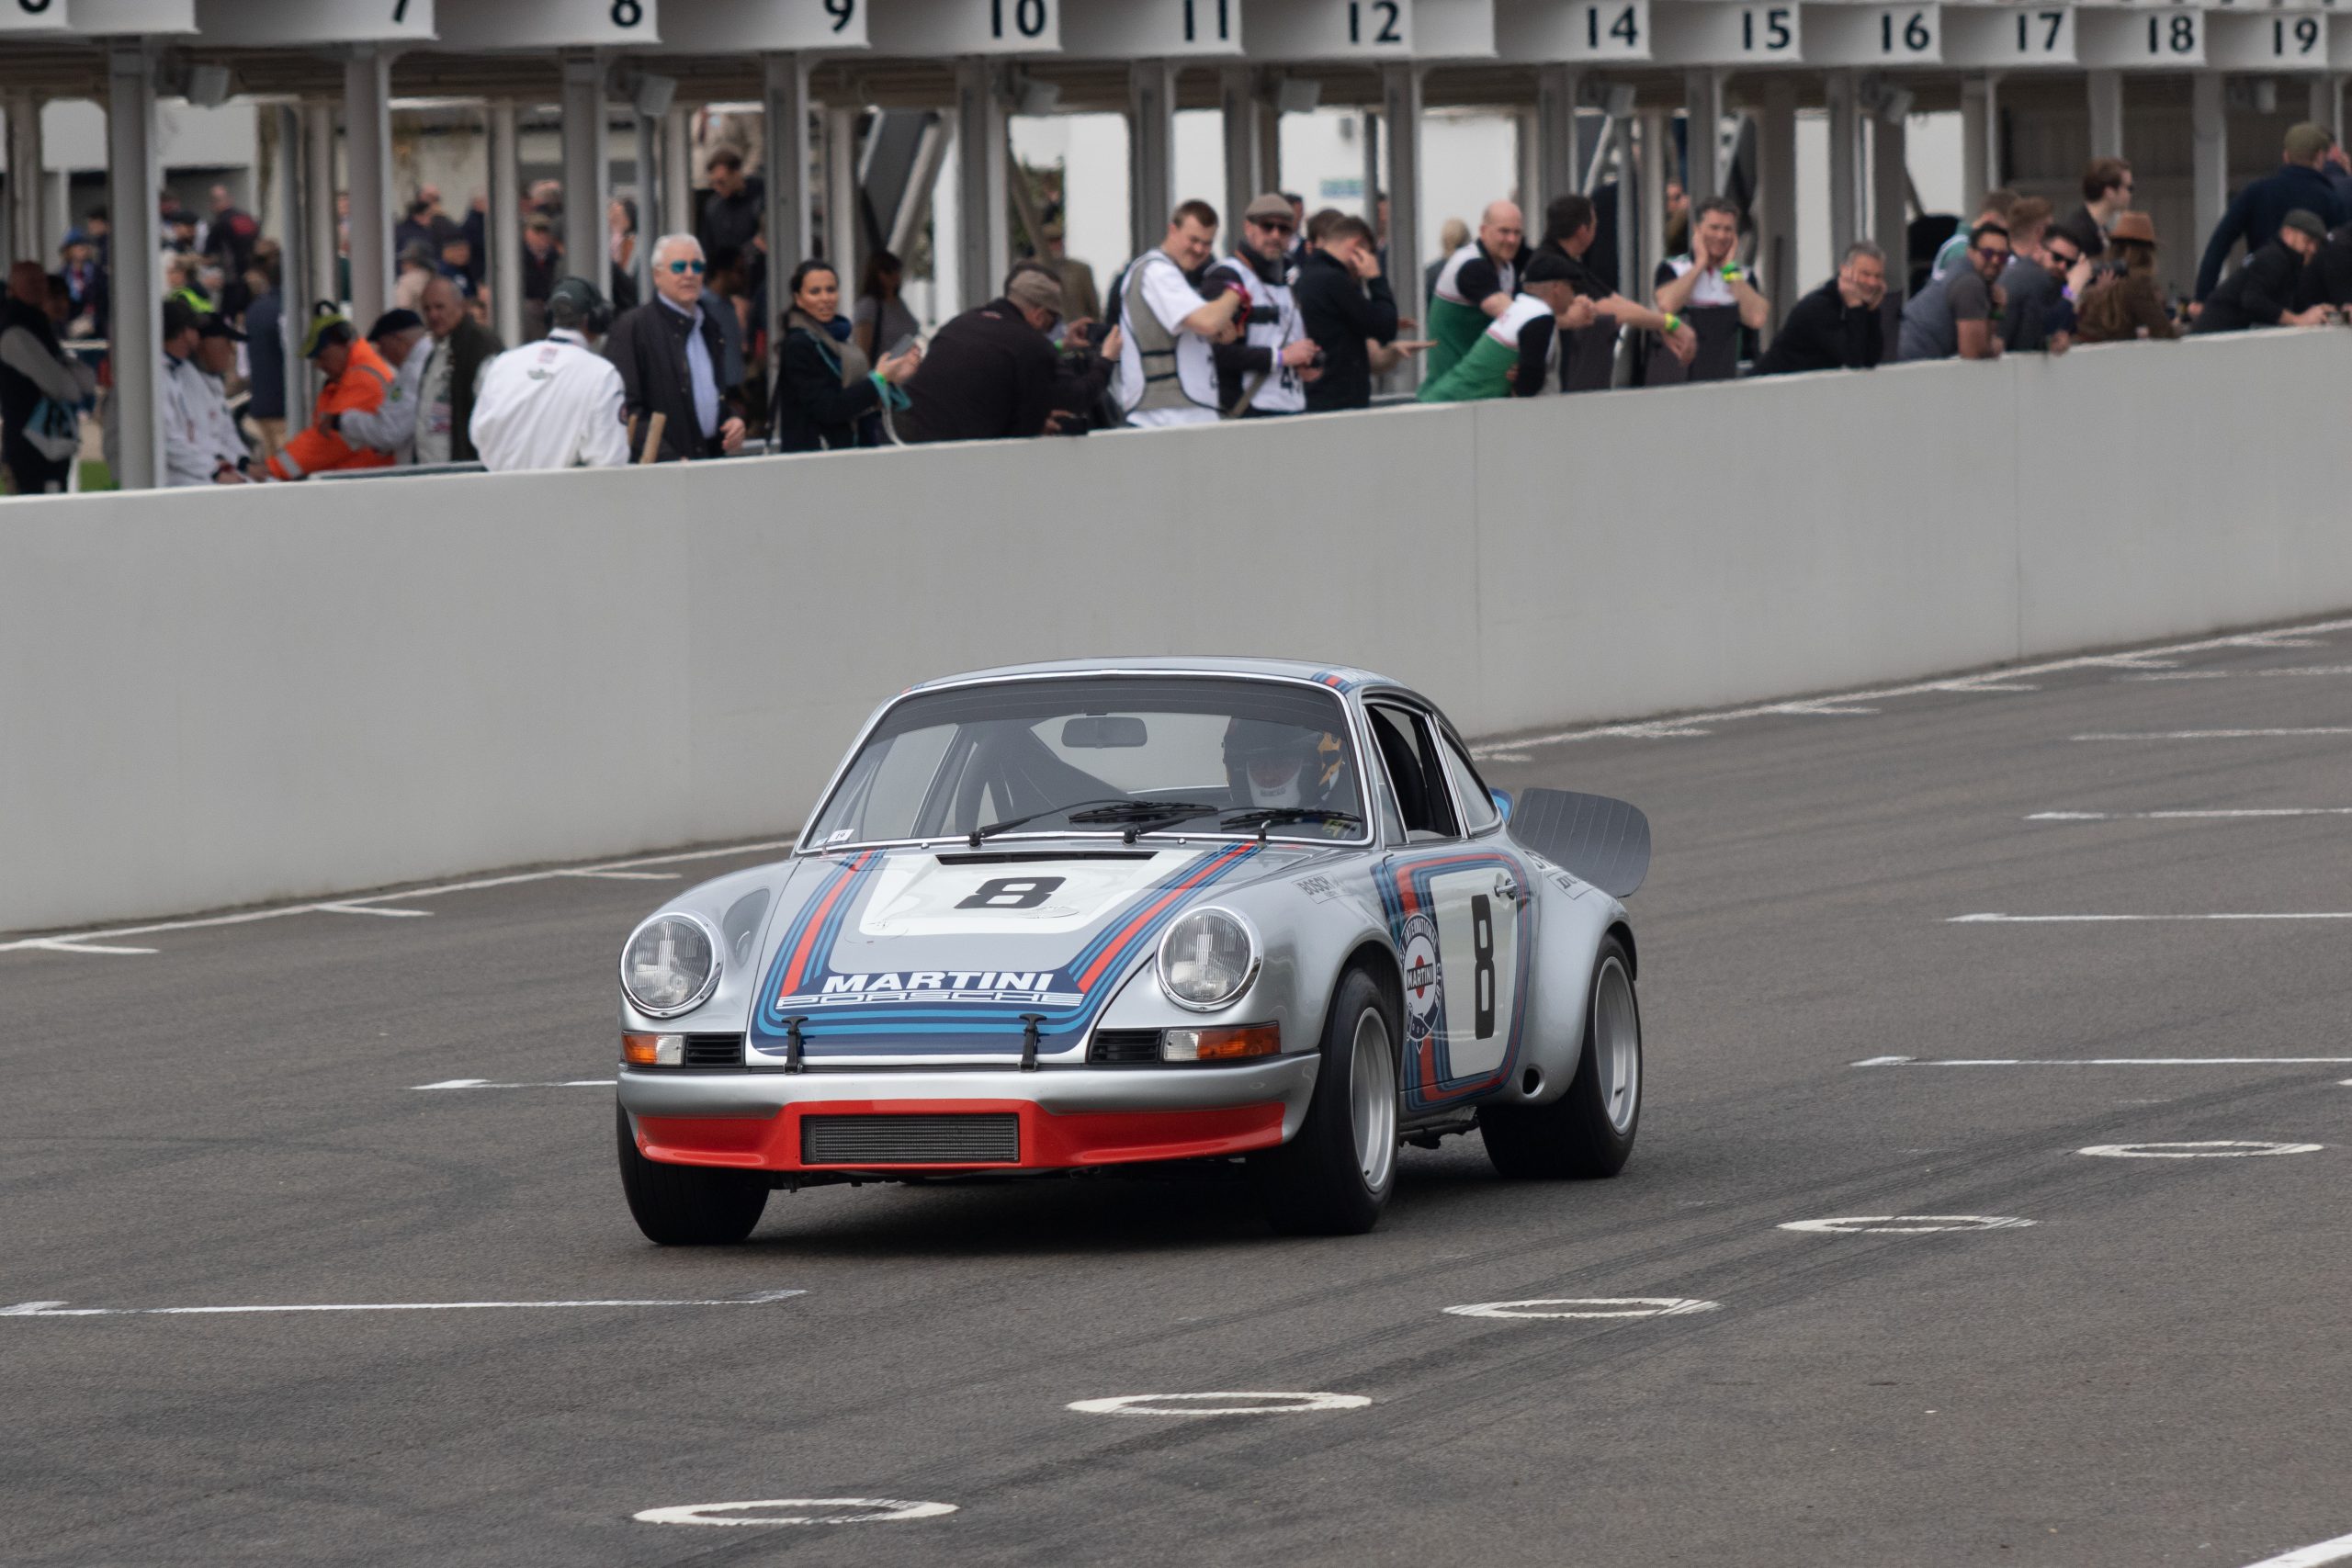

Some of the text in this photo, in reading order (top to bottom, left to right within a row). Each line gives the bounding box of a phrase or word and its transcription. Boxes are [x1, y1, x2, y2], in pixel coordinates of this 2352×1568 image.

[823, 0, 854, 33] 9
[991, 0, 1046, 38] 10
[1184, 0, 1228, 41] 11
[1349, 1, 1402, 43] 12
[1588, 6, 1638, 47] 14
[1743, 8, 1791, 50] 15
[1883, 13, 1930, 52] 16
[2018, 12, 2063, 52] 17
[2149, 15, 2195, 53] 18
[2274, 17, 2318, 55] 19
[954, 876, 1067, 909] 8
[1296, 875, 1334, 895] BOSCH
[821, 972, 1054, 993] MARTINI
[1407, 964, 1433, 988] MARTINI
[1472, 894, 1495, 1040] 8
[775, 990, 1085, 1010] PORSCHE
